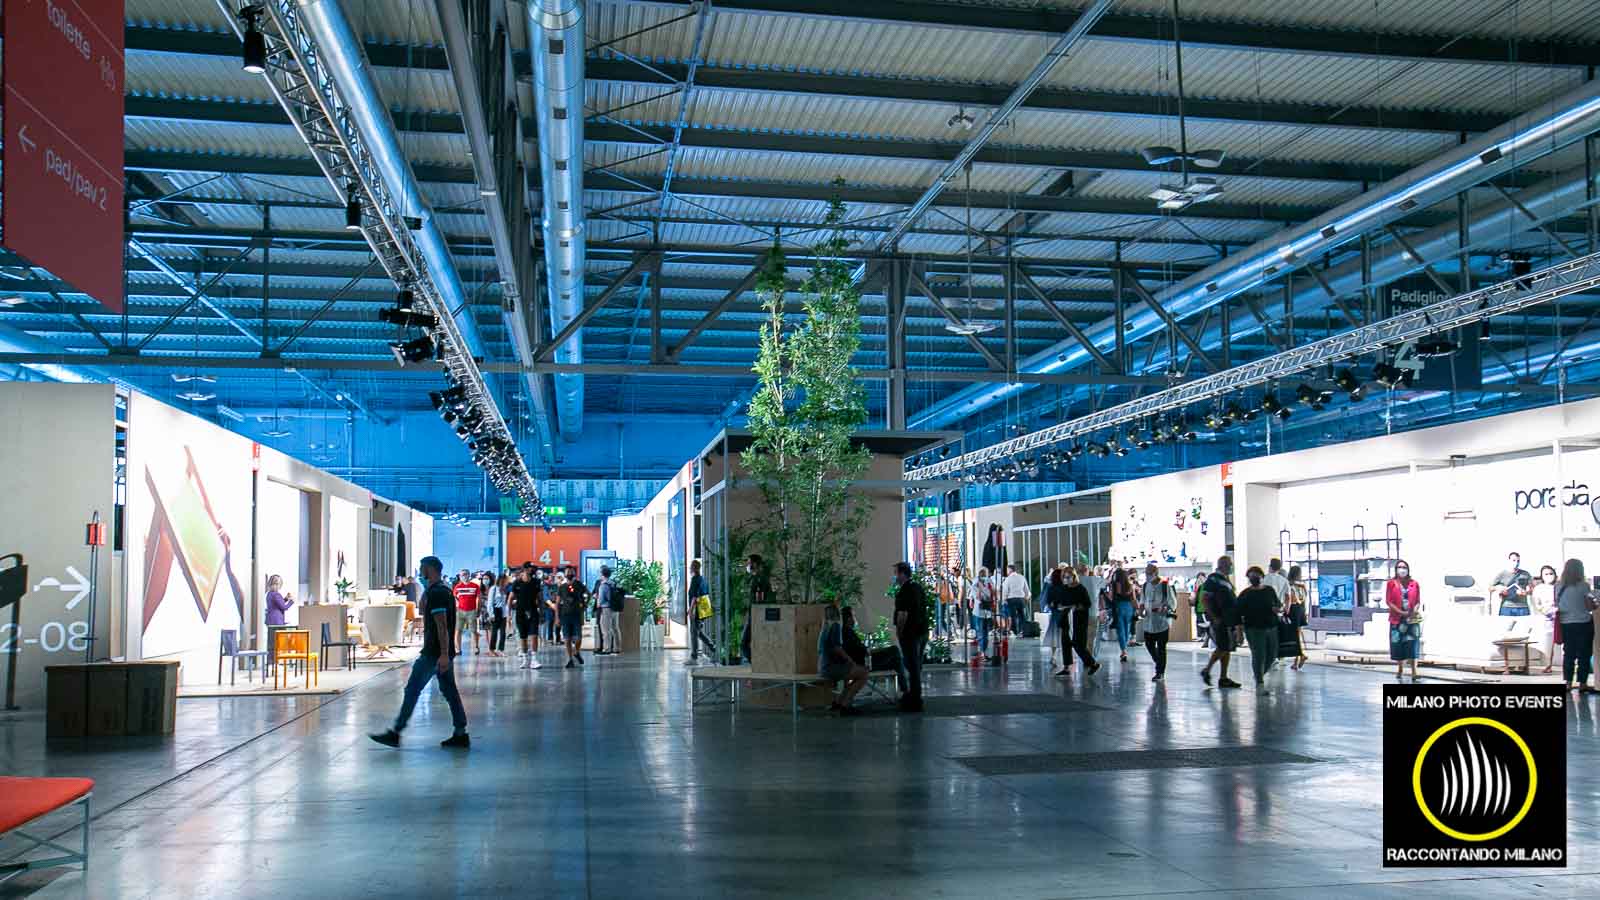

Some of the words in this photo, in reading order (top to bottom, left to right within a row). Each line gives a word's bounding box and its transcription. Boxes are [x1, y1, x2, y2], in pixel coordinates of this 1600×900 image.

[46, 0, 91, 60] toilette
[45, 149, 97, 204] pad/pav
[99, 187, 107, 211] 2
[540, 550, 553, 564] 4
